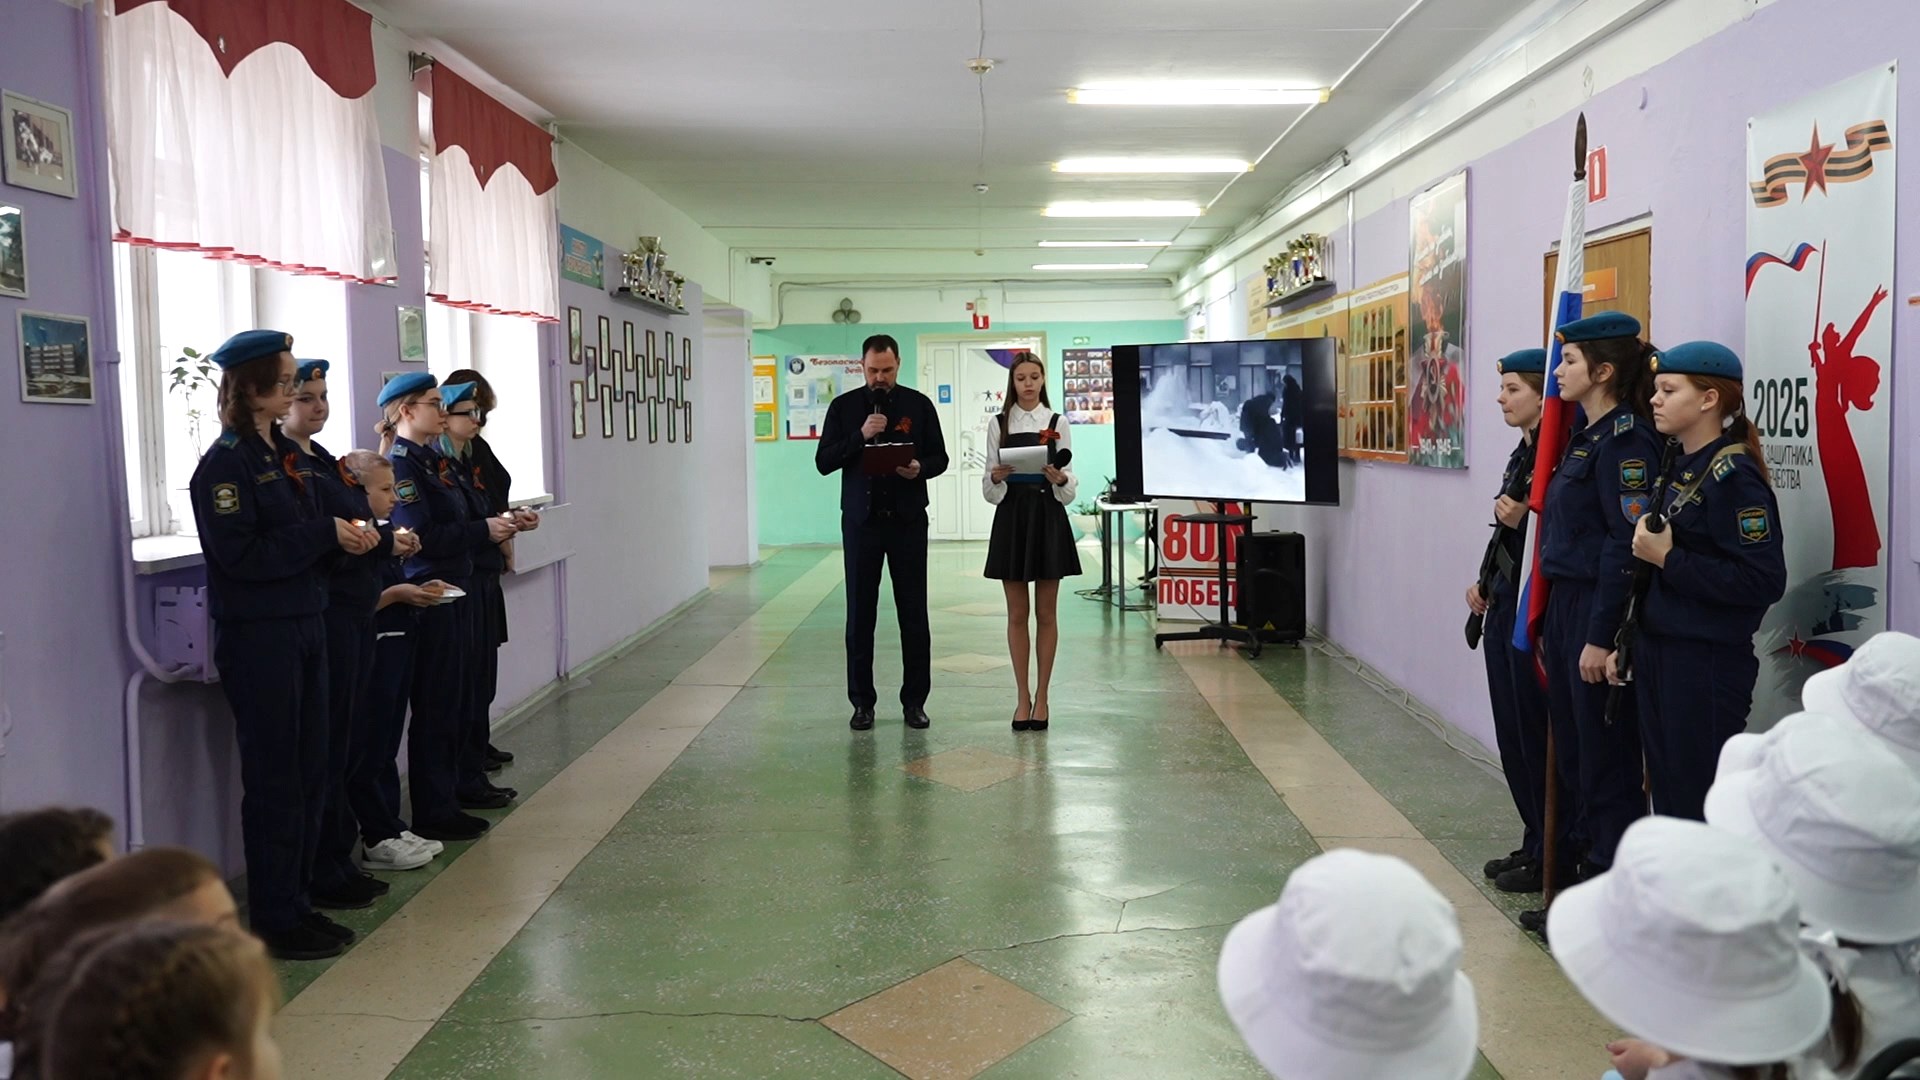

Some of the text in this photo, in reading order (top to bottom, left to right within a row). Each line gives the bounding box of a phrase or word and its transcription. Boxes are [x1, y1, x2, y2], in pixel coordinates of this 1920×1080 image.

[1753, 377, 1809, 438] 2025
[1766, 444, 1814, 467] ЗАЩИТНИКА
[1162, 513, 1216, 562] 80
[1158, 578, 1239, 610] ПОБЕД
